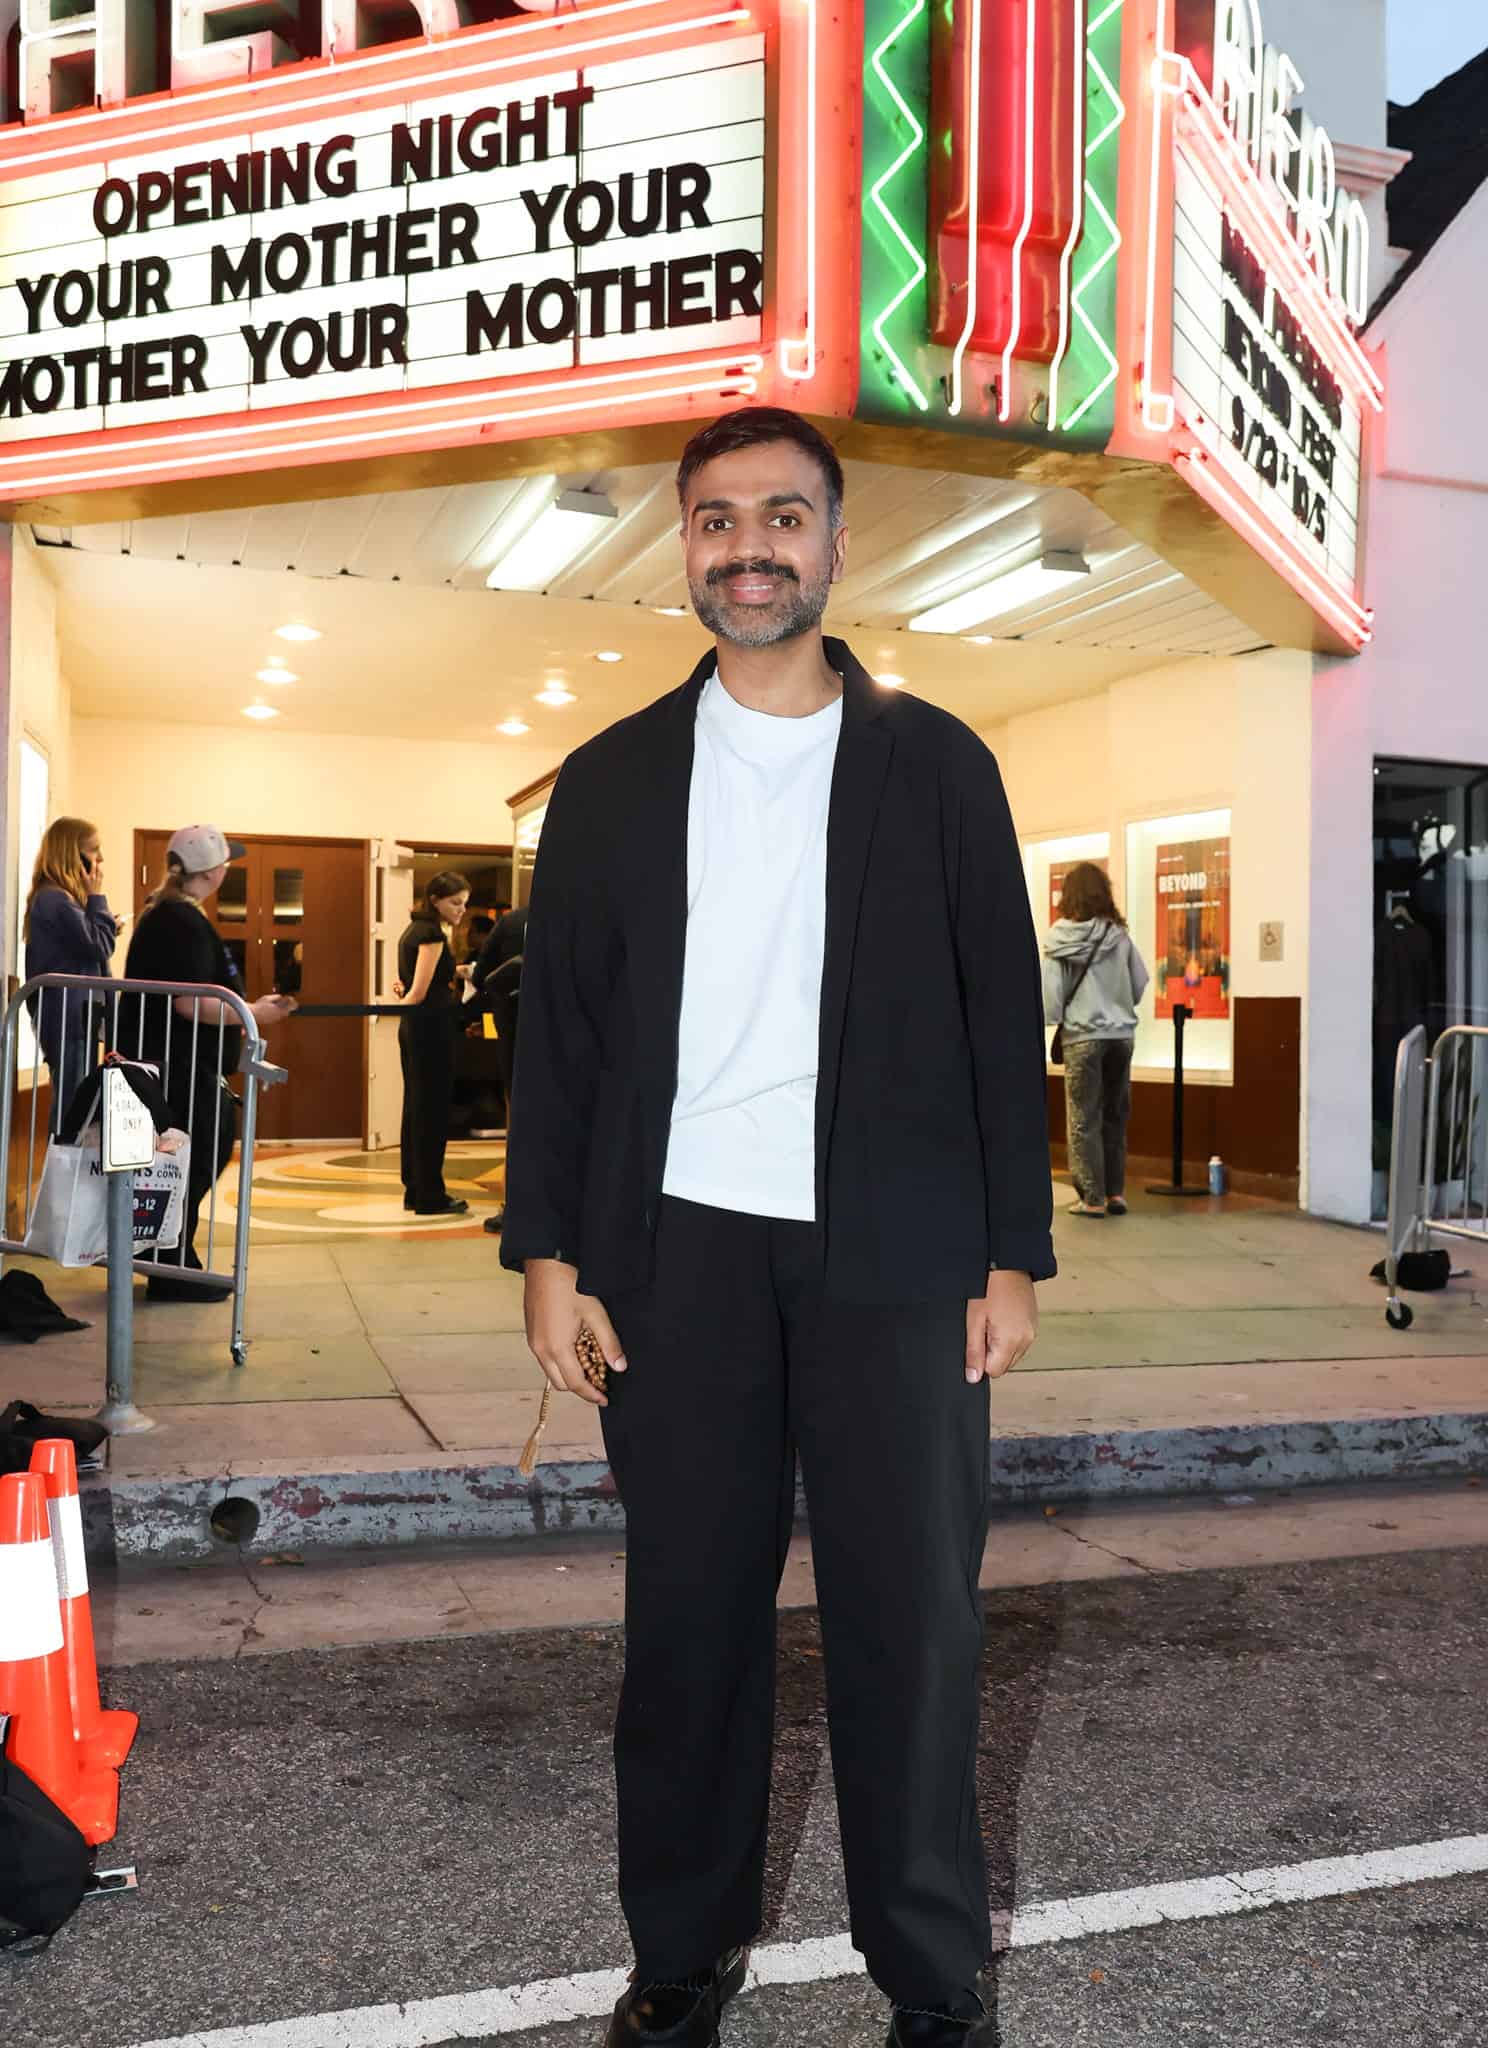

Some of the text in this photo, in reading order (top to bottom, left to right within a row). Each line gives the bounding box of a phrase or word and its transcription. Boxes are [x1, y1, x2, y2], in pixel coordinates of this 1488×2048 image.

[93, 86, 594, 238] OPENING NIGHT
[17, 162, 713, 333] YOUR MOTHER YOUR
[240, 303, 409, 384] YOUR
[466, 248, 764, 355] MOTHER
[1159, 872, 1207, 893] BEYOND
